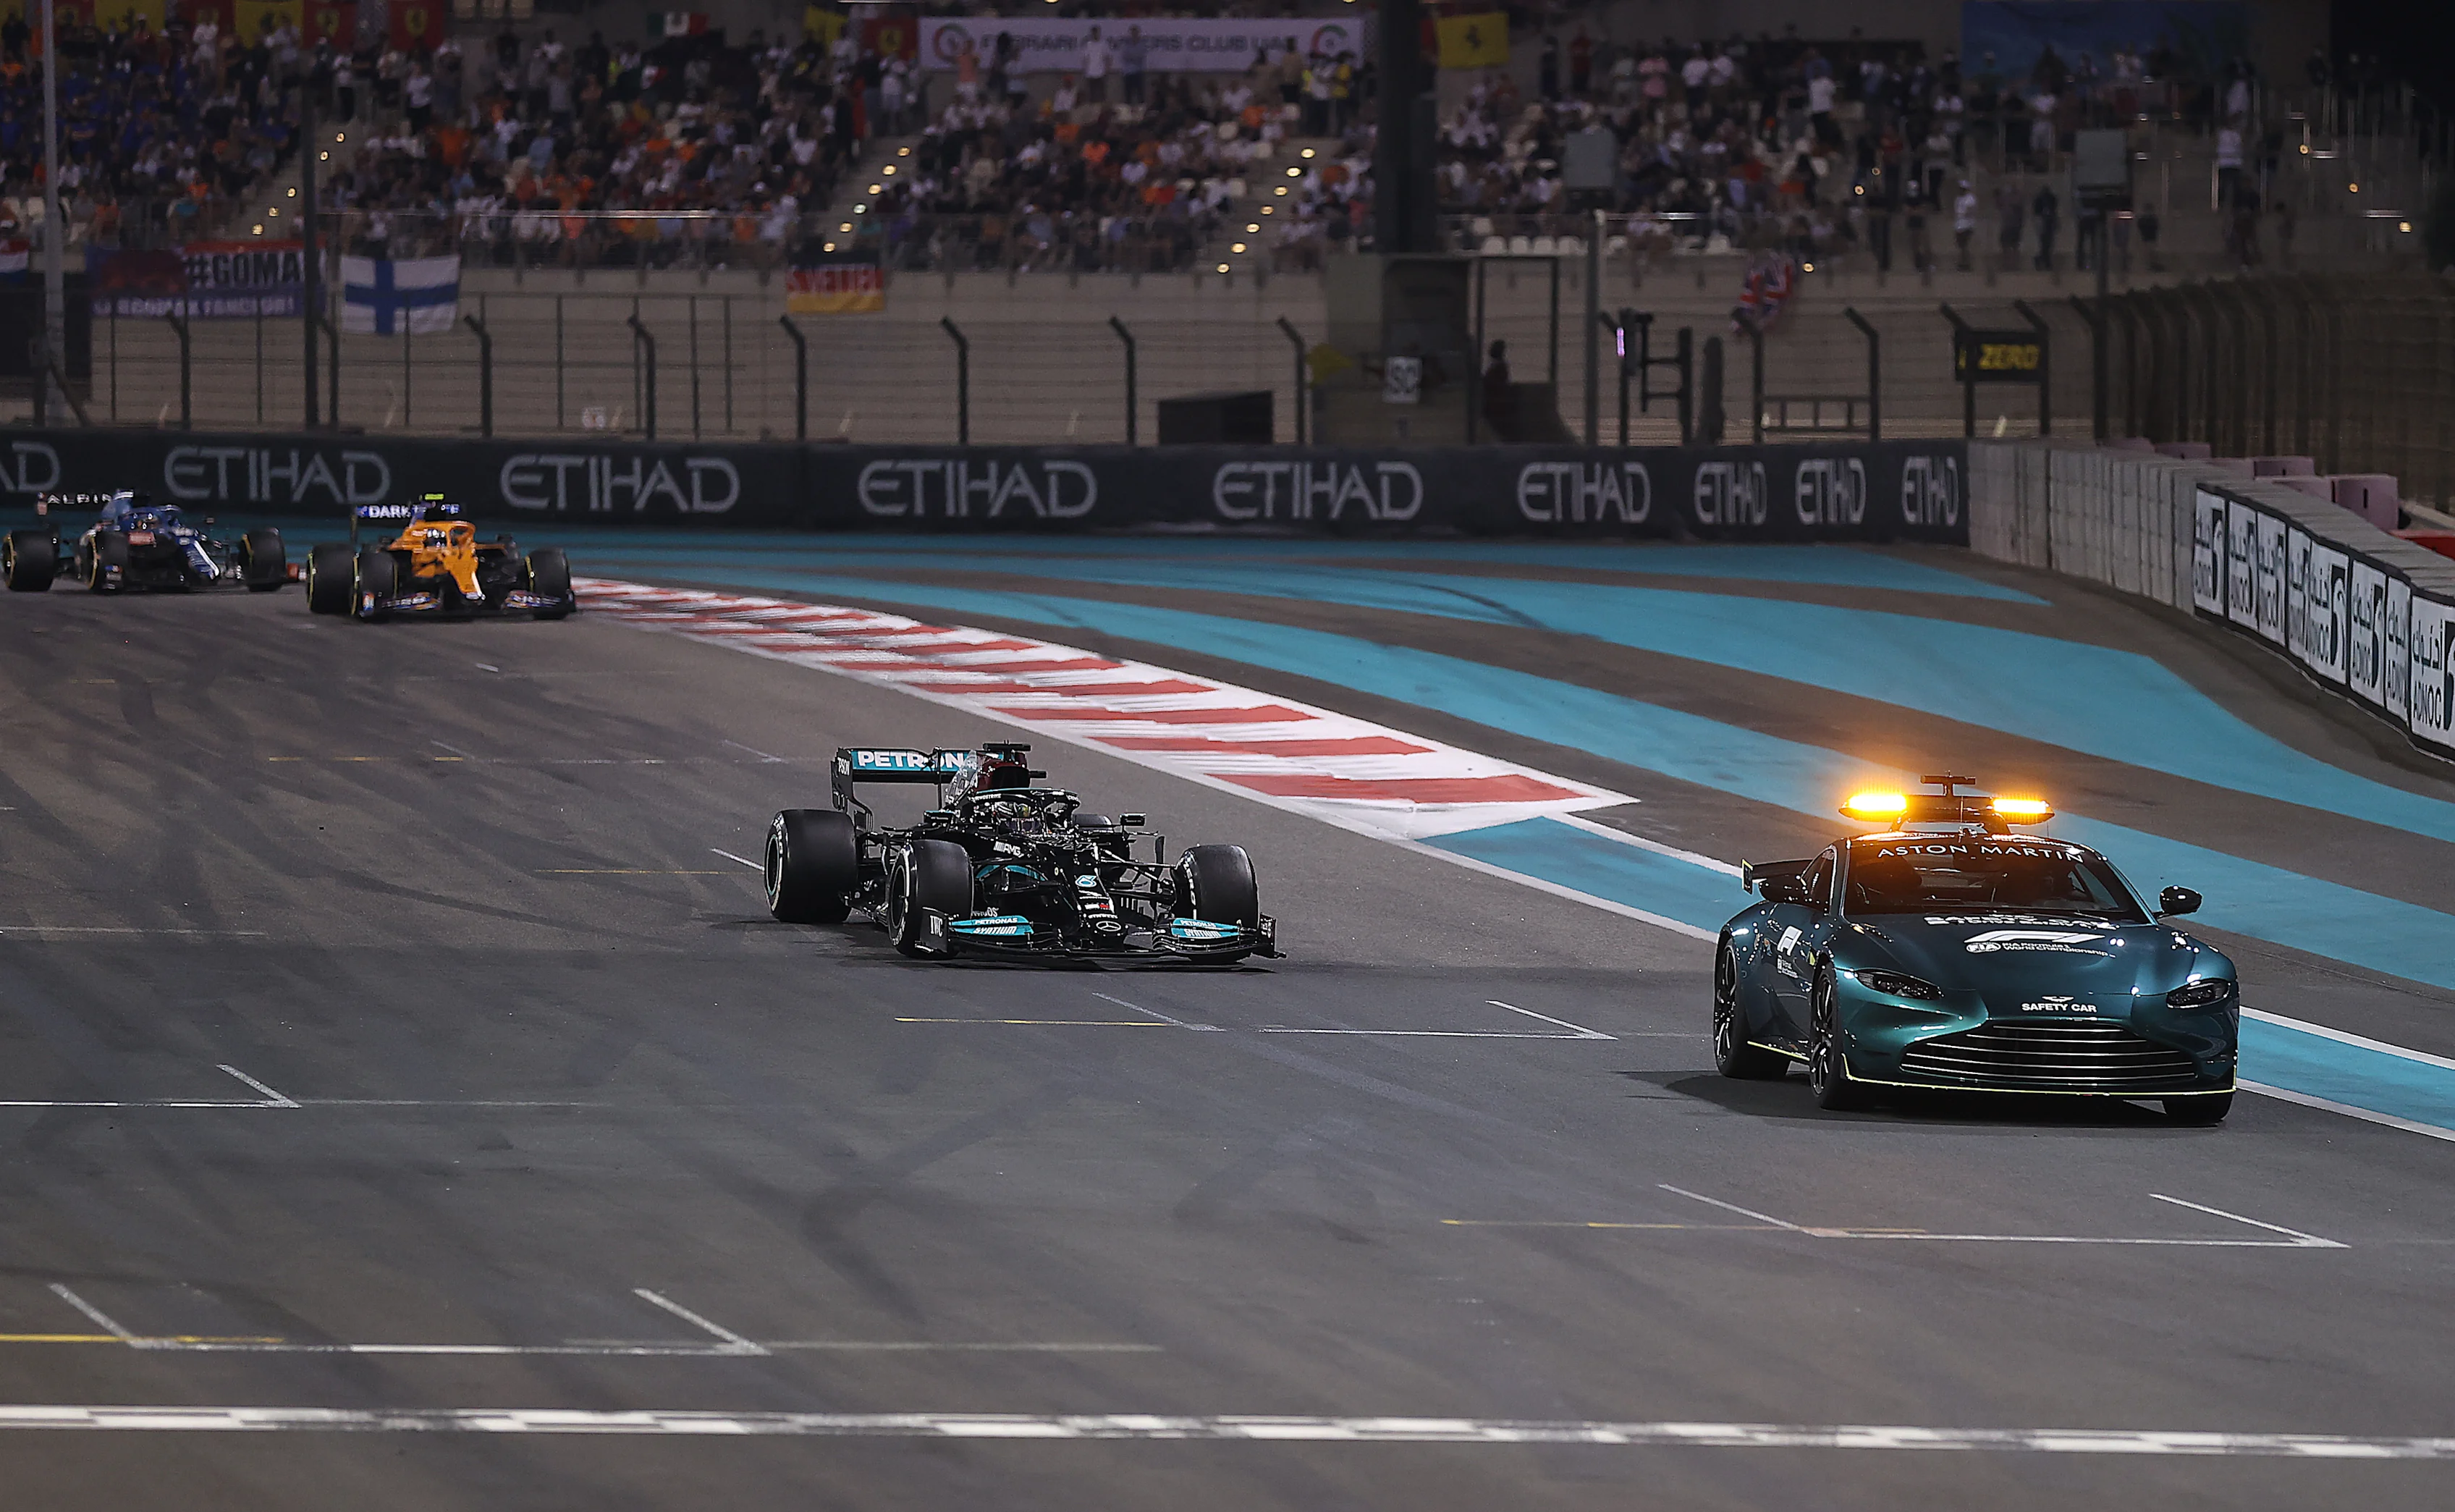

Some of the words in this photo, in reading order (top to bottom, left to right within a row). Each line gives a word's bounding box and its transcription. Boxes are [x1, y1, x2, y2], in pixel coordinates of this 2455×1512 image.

[981, 33, 1078, 51] FRRARI
[182, 251, 307, 284] #GOMA
[164, 445, 391, 504] ETIHAD
[500, 454, 741, 513] ETIHAD
[857, 460, 1099, 518] ETIHAD
[1212, 460, 1424, 521] ETIHAD
[1517, 462, 1651, 523] ETIHAD
[1694, 461, 1768, 525] ETIHAD
[1796, 457, 1867, 525] ETIHAD
[1901, 455, 1959, 526] ETIHAD
[2414, 680, 2442, 730] ADNOC
[1003, 844, 1022, 857] AMG
[1878, 845, 1969, 858] ASTON
[1981, 845, 2084, 863] MARTIN
[973, 926, 1018, 935] SYNTIUM
[1966, 942, 2001, 953] FIA
[2037, 946, 2108, 956] Championship
[2071, 1003, 2097, 1013] CAR
